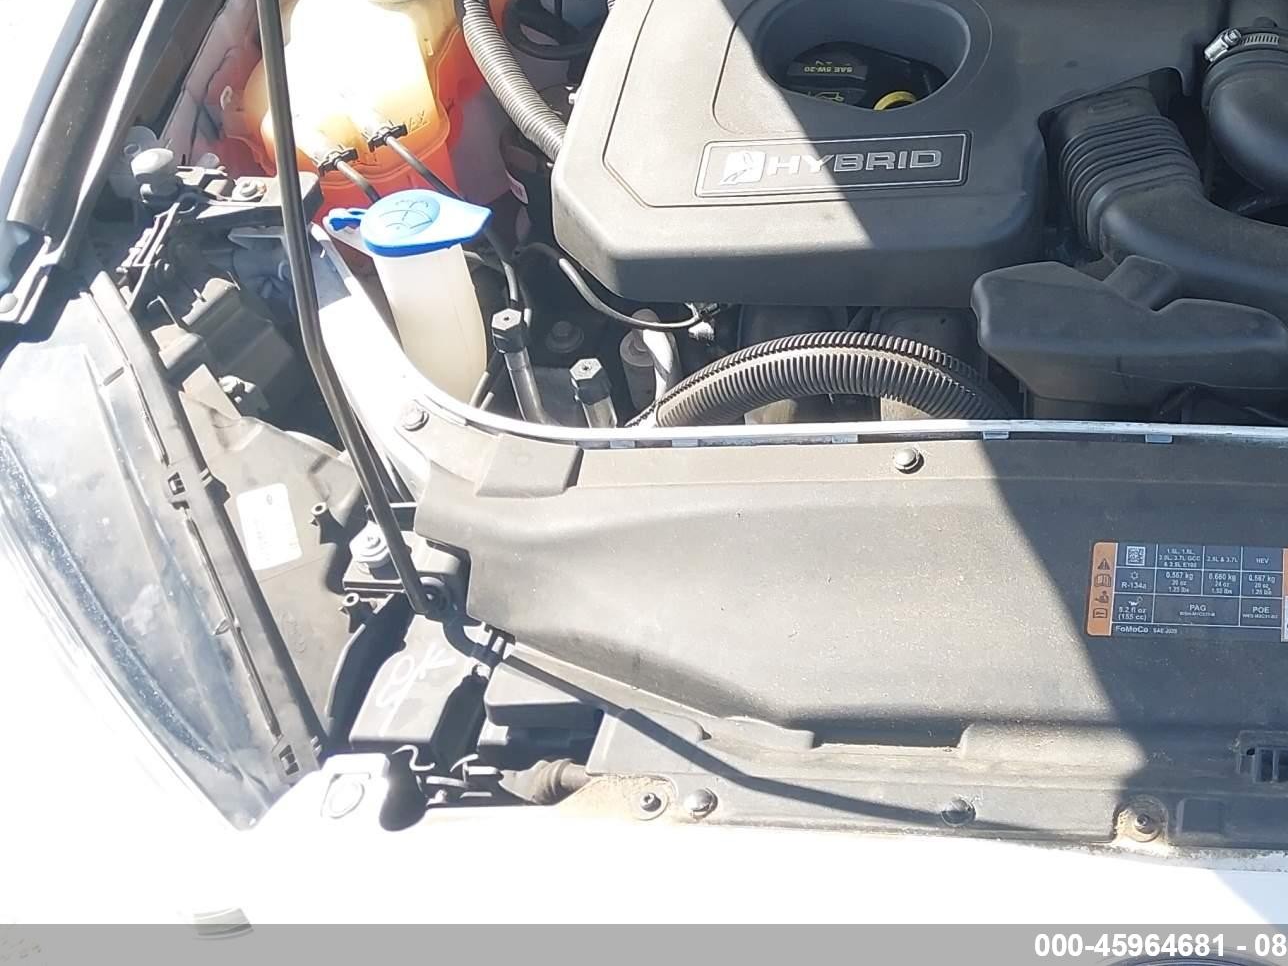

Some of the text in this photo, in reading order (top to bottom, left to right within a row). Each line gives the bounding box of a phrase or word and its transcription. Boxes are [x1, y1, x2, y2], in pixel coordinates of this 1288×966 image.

[766, 150, 943, 176] HYBRID
[1121, 582, 1146, 590] R-134a
[1252, 606, 1270, 614] POE
